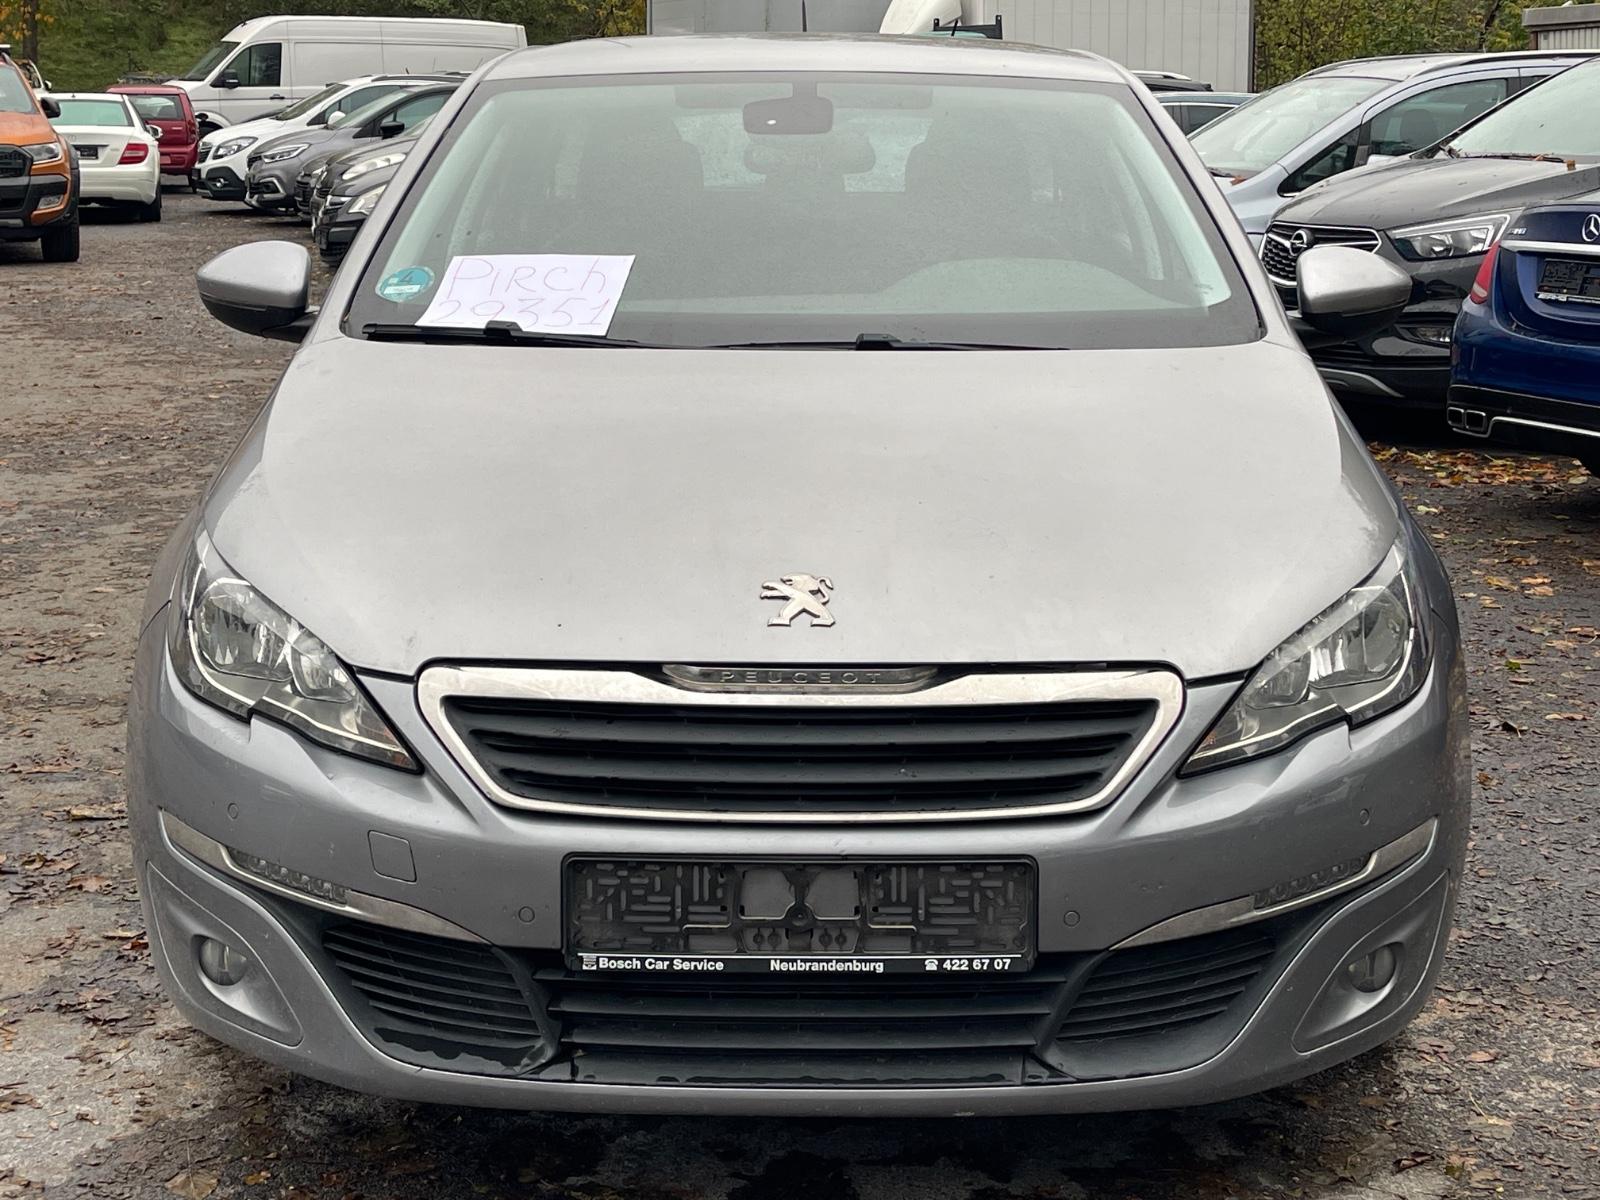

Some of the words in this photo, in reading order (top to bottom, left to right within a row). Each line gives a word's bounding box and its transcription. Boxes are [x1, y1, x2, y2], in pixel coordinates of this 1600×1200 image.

[428, 297, 610, 328] 29351
[719, 671, 881, 684] PEUGEOT
[598, 957, 641, 970] Bosch
[645, 958, 670, 971] Car
[672, 958, 725, 971] Service
[769, 959, 884, 973] Neubrandenburg
[942, 958, 969, 971] 422
[972, 958, 990, 971] 67
[993, 958, 1011, 971] 07
